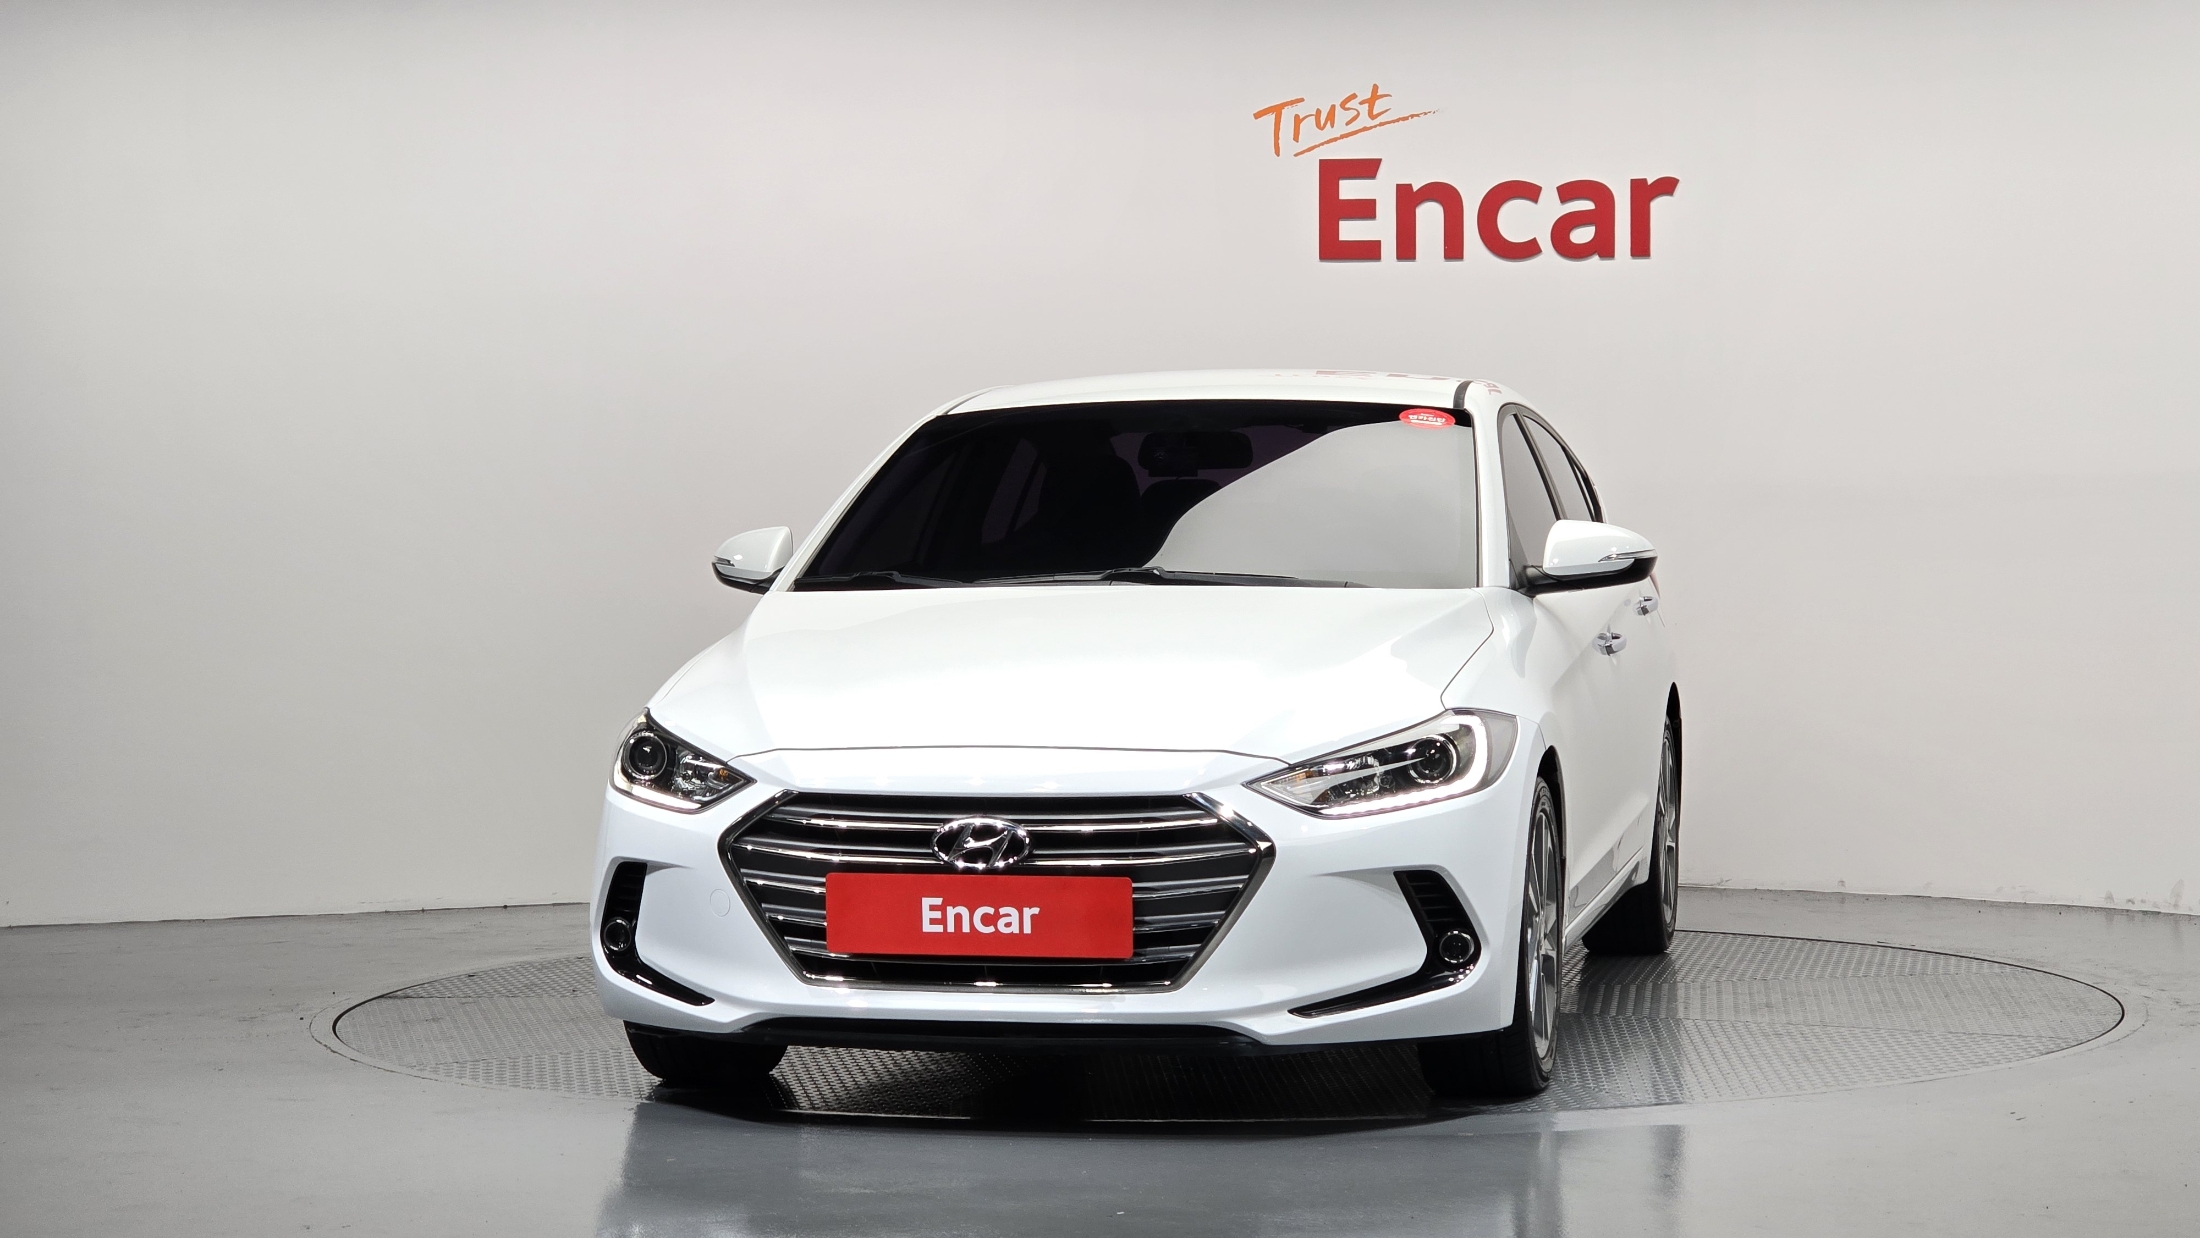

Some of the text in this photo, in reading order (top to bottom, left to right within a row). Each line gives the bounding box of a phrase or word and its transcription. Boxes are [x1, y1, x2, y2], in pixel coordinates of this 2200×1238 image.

[1253, 83, 1393, 157] Trust
[1318, 157, 1680, 262] Encar
[921, 897, 1041, 934] Encar
